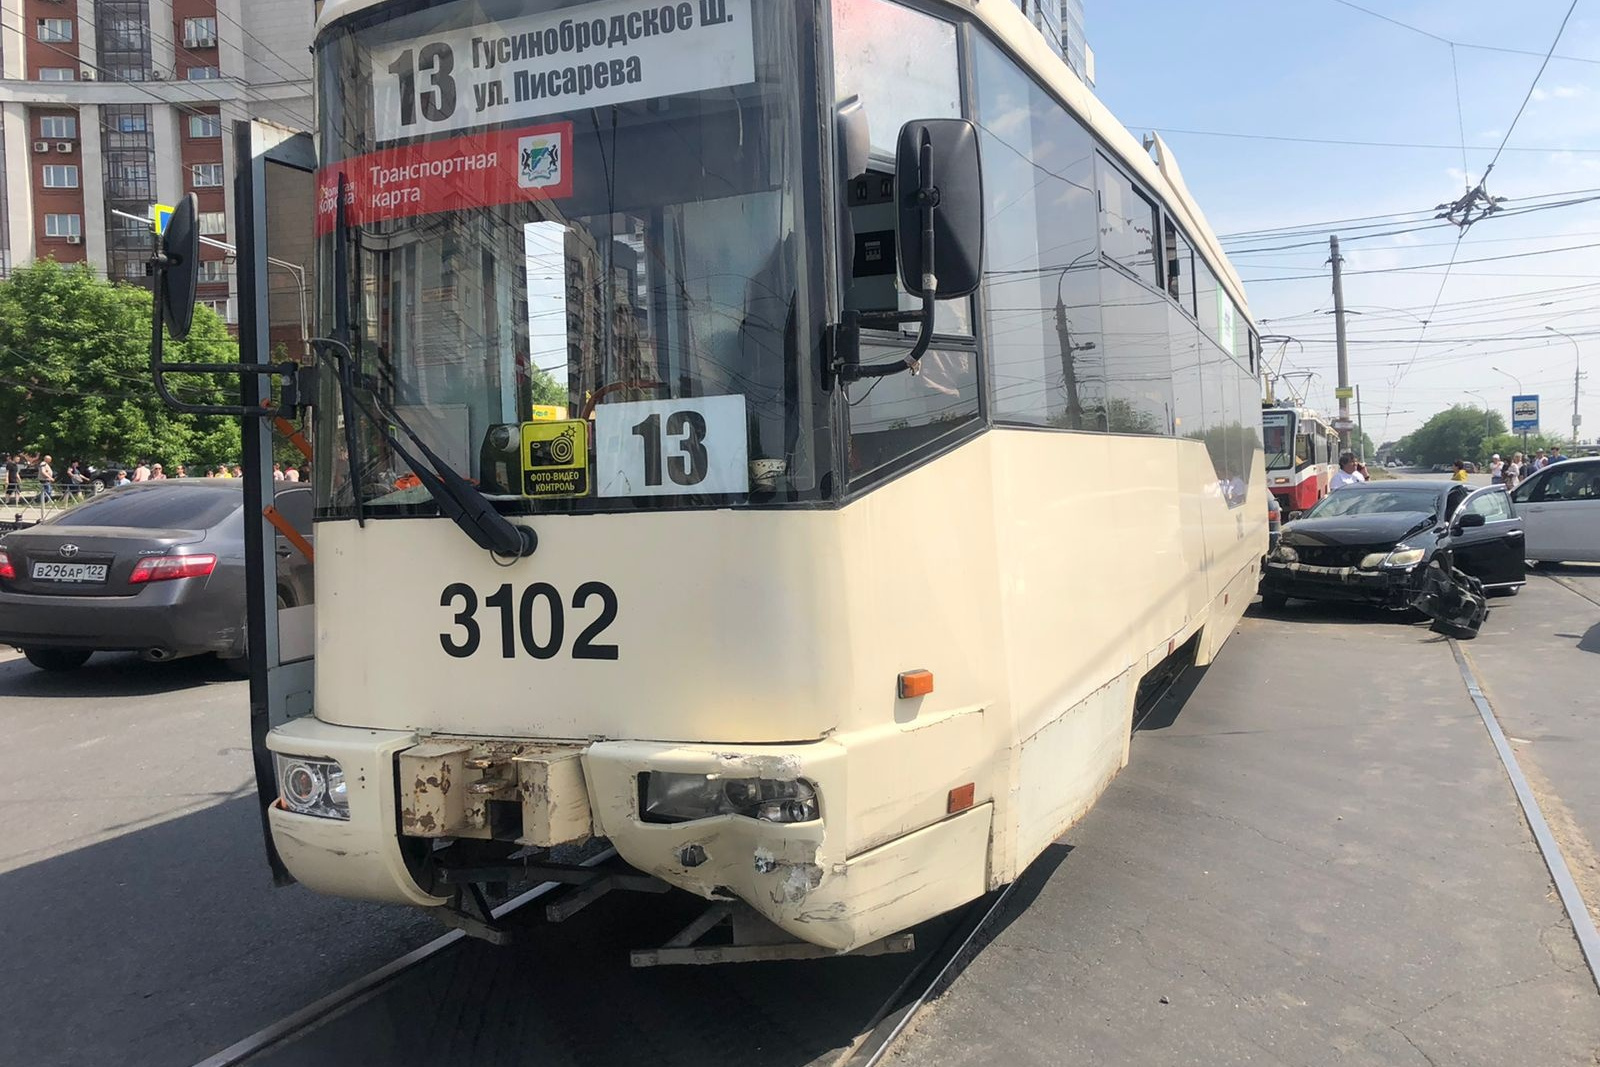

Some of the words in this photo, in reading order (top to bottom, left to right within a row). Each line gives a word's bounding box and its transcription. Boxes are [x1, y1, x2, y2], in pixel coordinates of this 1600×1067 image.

[472, 1, 693, 70] Гусинобродское
[388, 41, 457, 126] 13
[473, 79, 510, 112] ул.
[513, 55, 643, 102] Писарева
[370, 152, 497, 188] Транспортная
[371, 186, 421, 209] карта
[530, 471, 580, 481] ФОТО-ВИДЕО
[631, 410, 708, 487] 13
[535, 482, 576, 492] КОНТРОЛЬ
[439, 581, 619, 660] 3102
